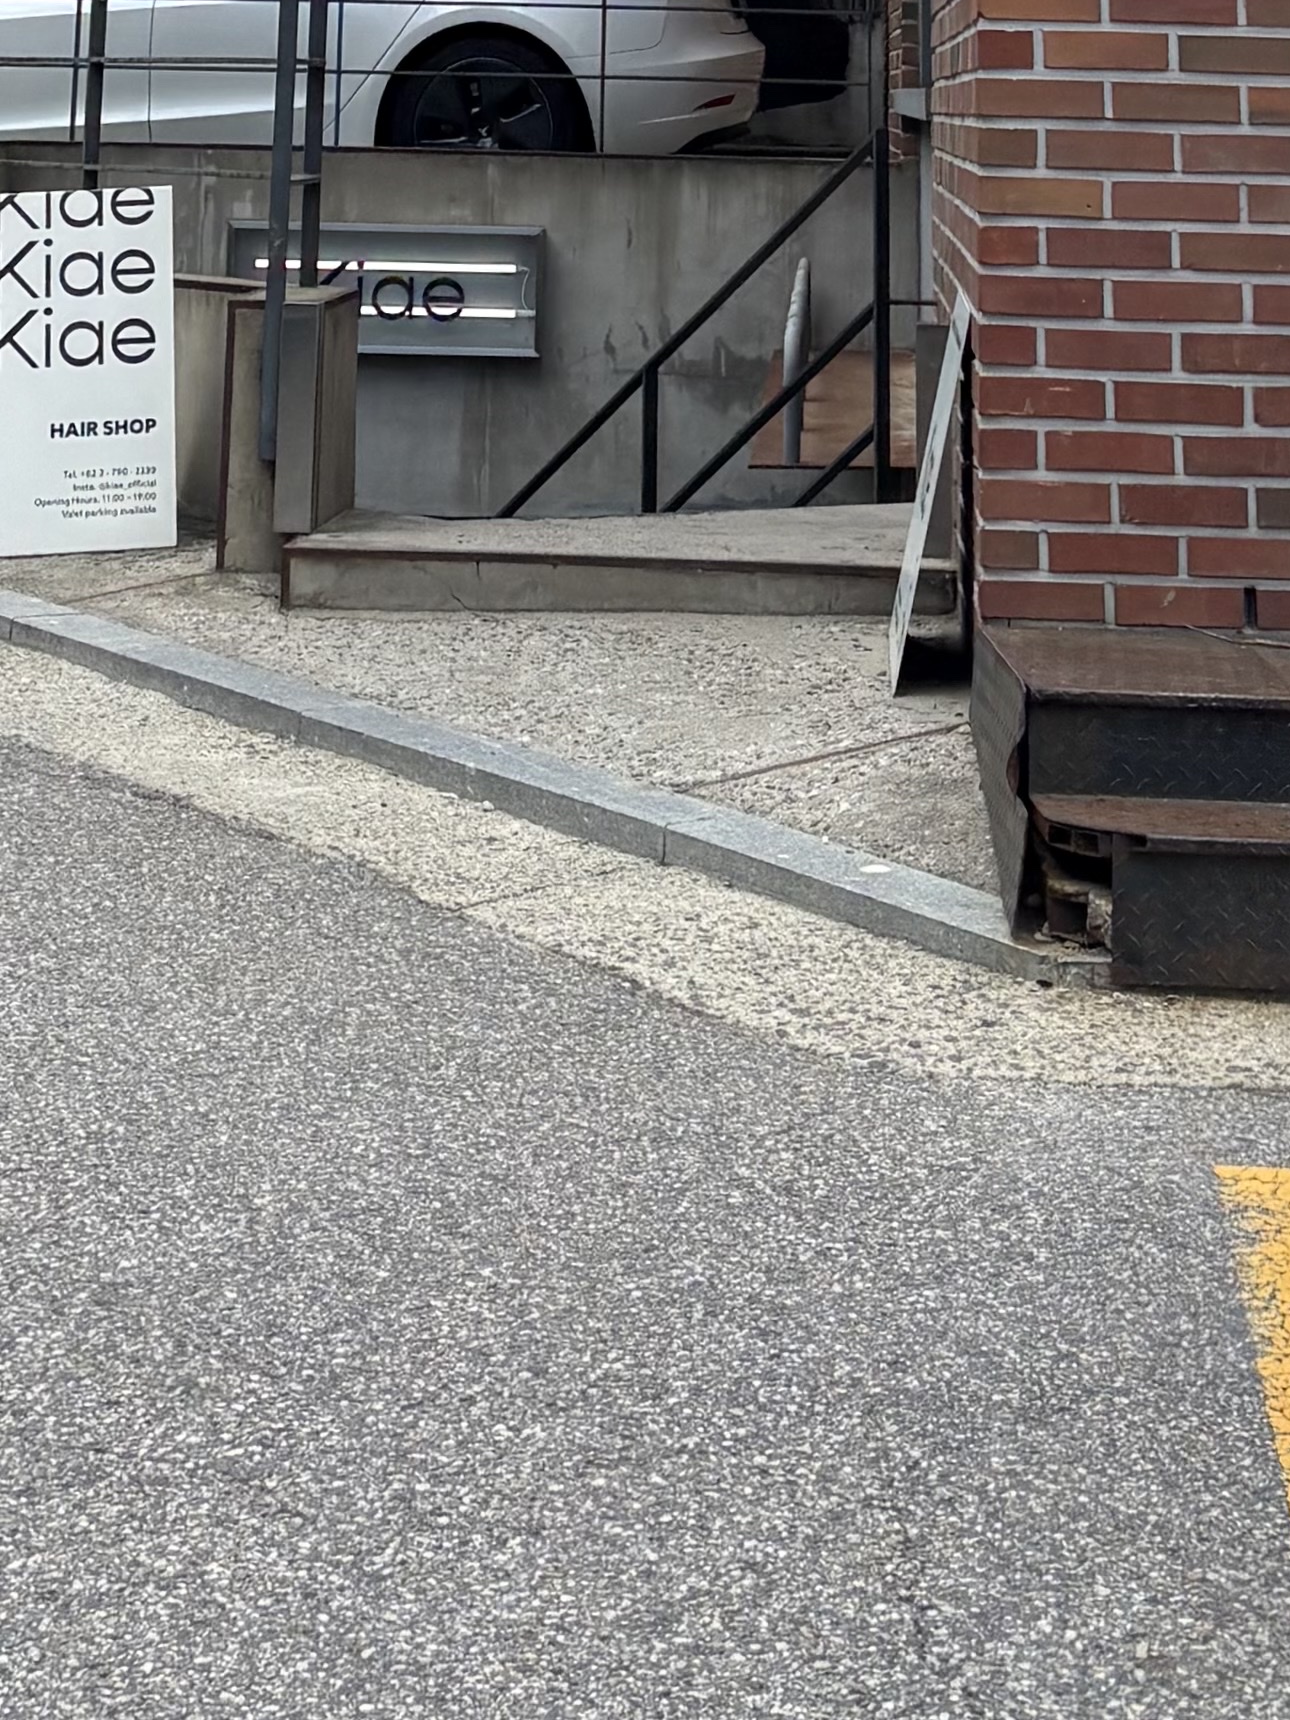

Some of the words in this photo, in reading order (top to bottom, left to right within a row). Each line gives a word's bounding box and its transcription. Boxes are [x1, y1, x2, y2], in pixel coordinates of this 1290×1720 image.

[0, 238, 155, 298] Kiae
[320, 260, 465, 322] iae
[0, 307, 156, 368] Kiae
[50, 421, 99, 439] HAIR
[103, 418, 157, 436] SHOP
[85, 508, 118, 519] parking
